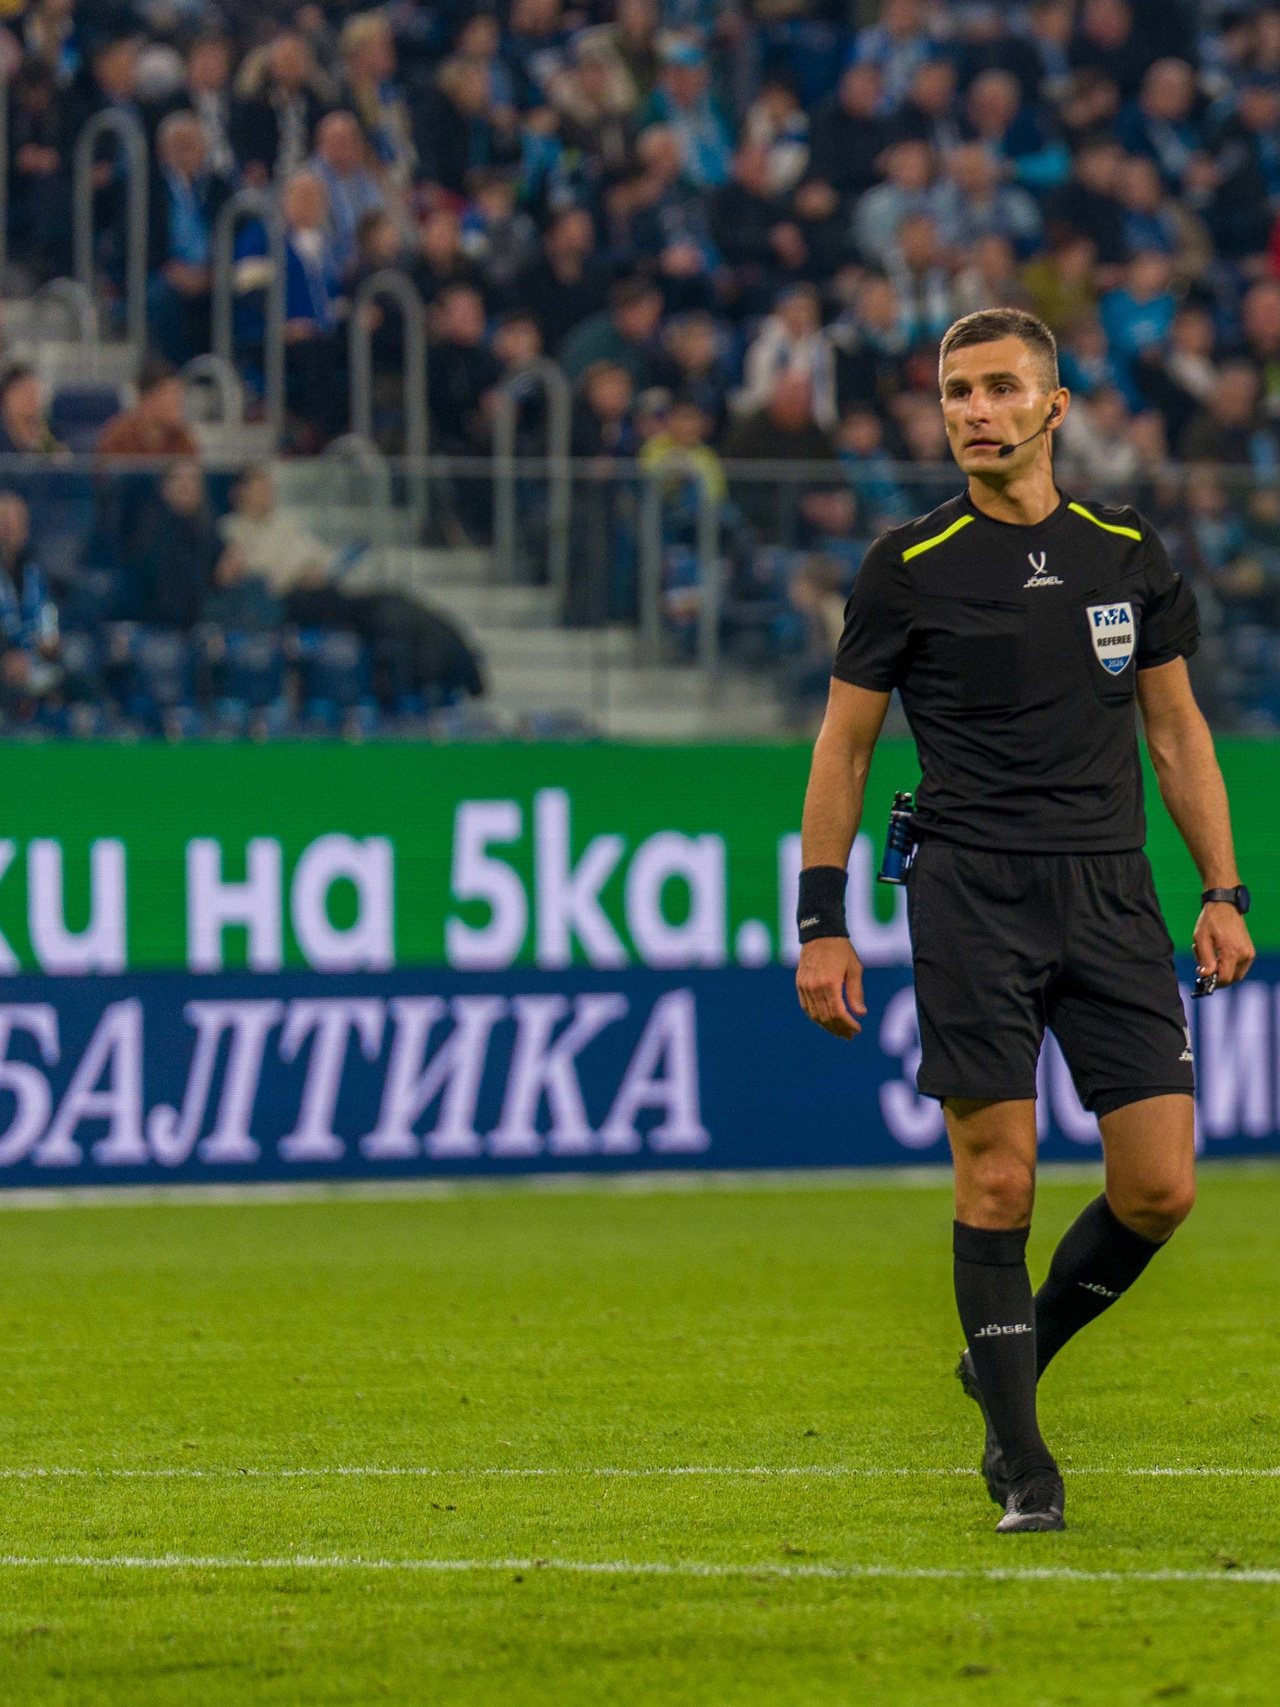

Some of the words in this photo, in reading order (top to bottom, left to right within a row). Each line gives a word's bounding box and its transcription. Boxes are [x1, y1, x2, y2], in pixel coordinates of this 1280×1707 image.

[1093, 608, 1130, 627] FIFA
[1097, 634, 1132, 647] REFEREE
[0, 836, 128, 976] и
[185, 833, 396, 974] на
[974, 1323, 1032, 1338] JÖGEL
